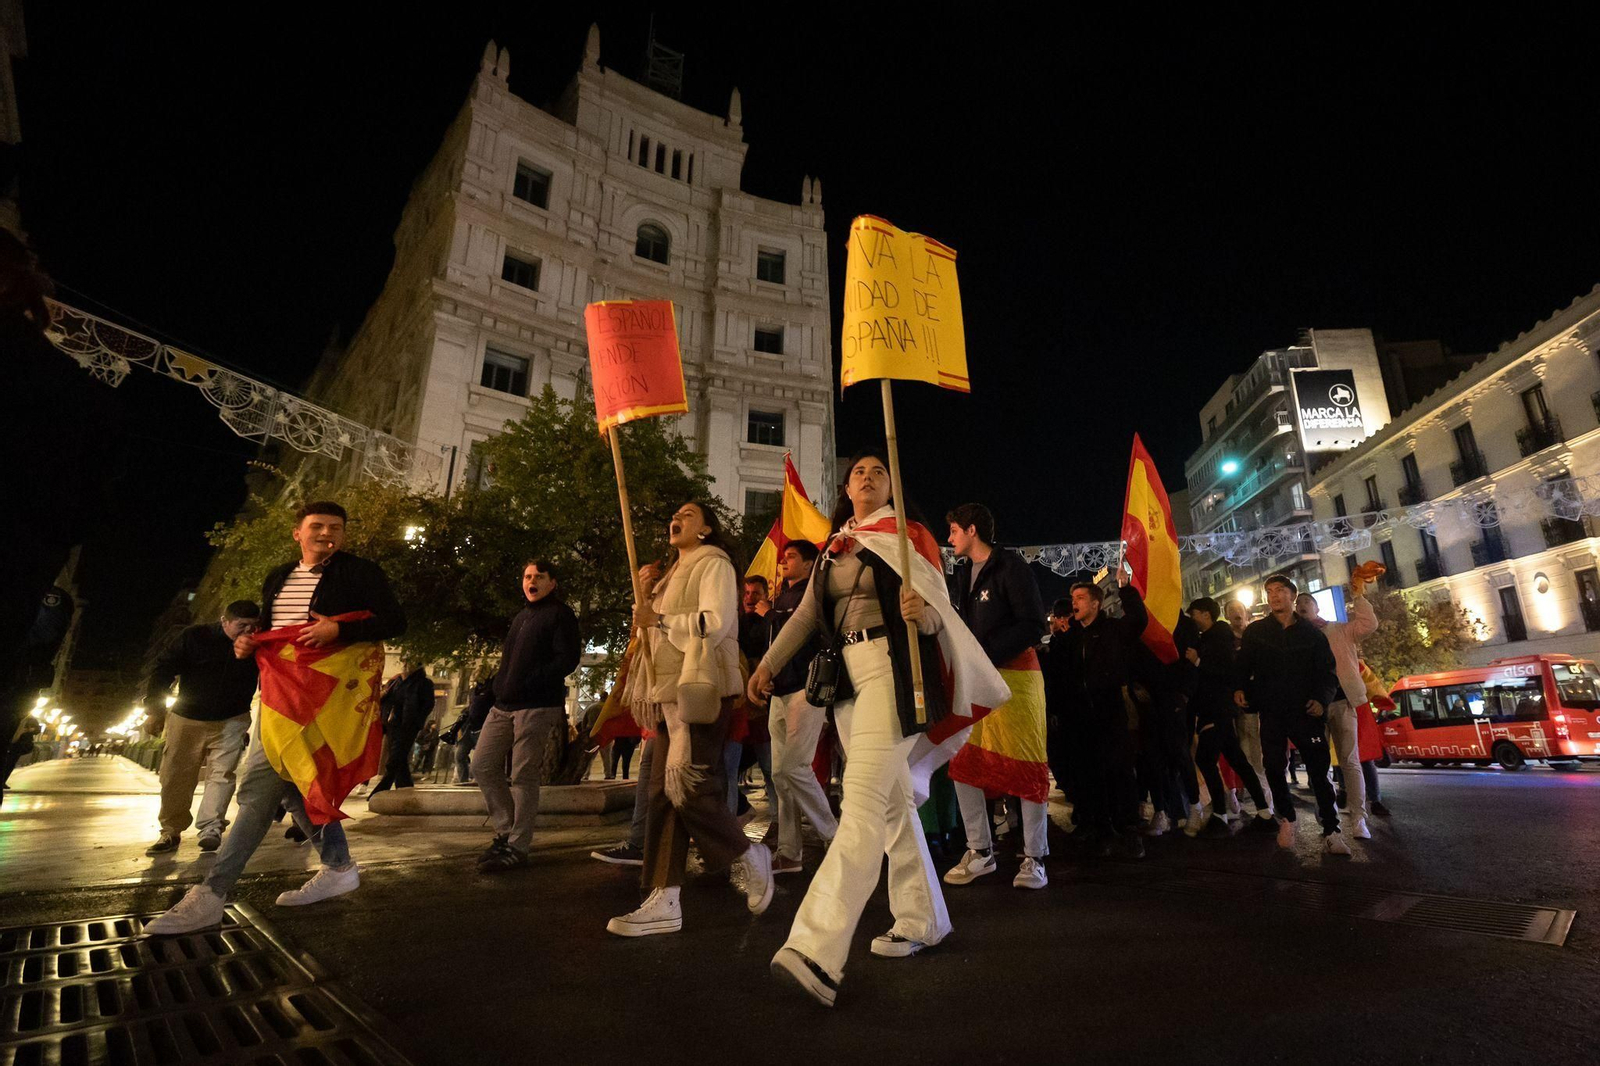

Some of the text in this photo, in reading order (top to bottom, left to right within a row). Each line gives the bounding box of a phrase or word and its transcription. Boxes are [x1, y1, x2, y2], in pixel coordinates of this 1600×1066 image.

[910, 246, 943, 290] LA
[913, 288, 941, 322] DE
[1301, 406, 1361, 419] MARCA LA
[1503, 665, 1535, 678] alsa
